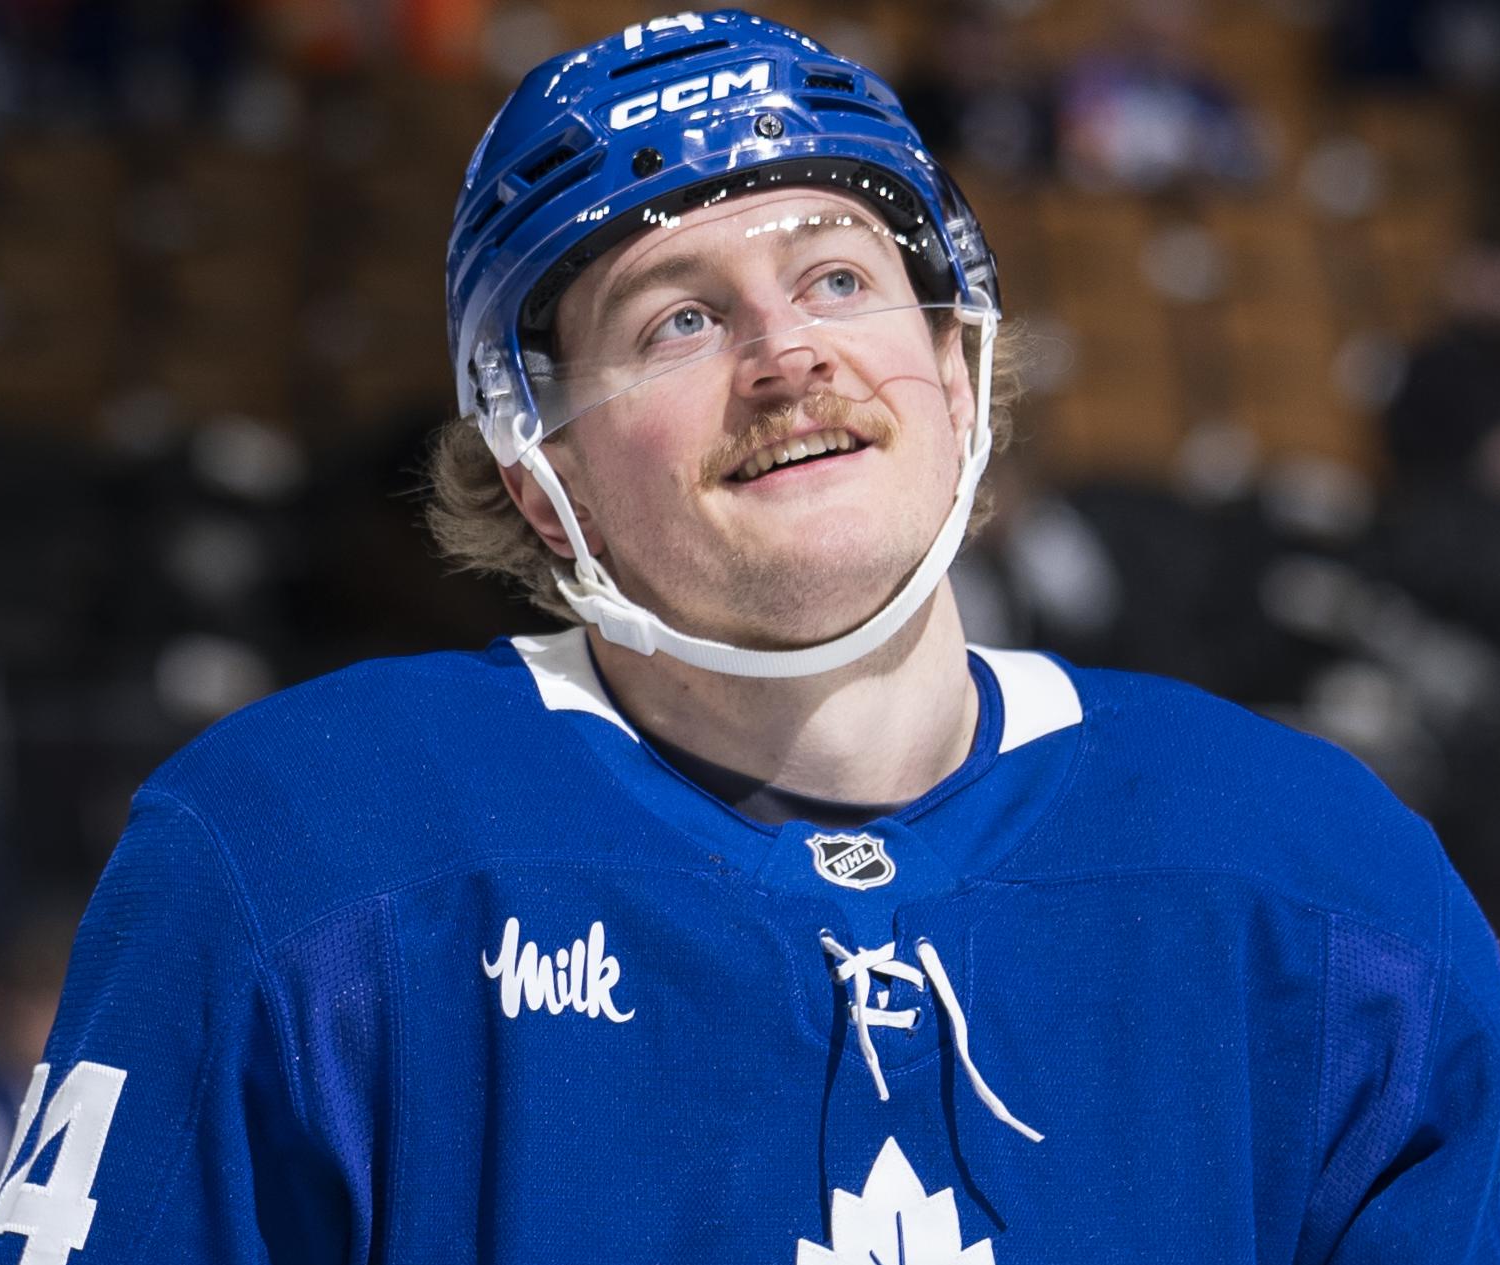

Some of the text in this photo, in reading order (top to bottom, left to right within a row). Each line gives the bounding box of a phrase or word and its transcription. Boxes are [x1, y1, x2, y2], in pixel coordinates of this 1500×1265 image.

[610, 61, 770, 131] CCM
[832, 846, 874, 877] NHL
[482, 916, 636, 1023] Milk
